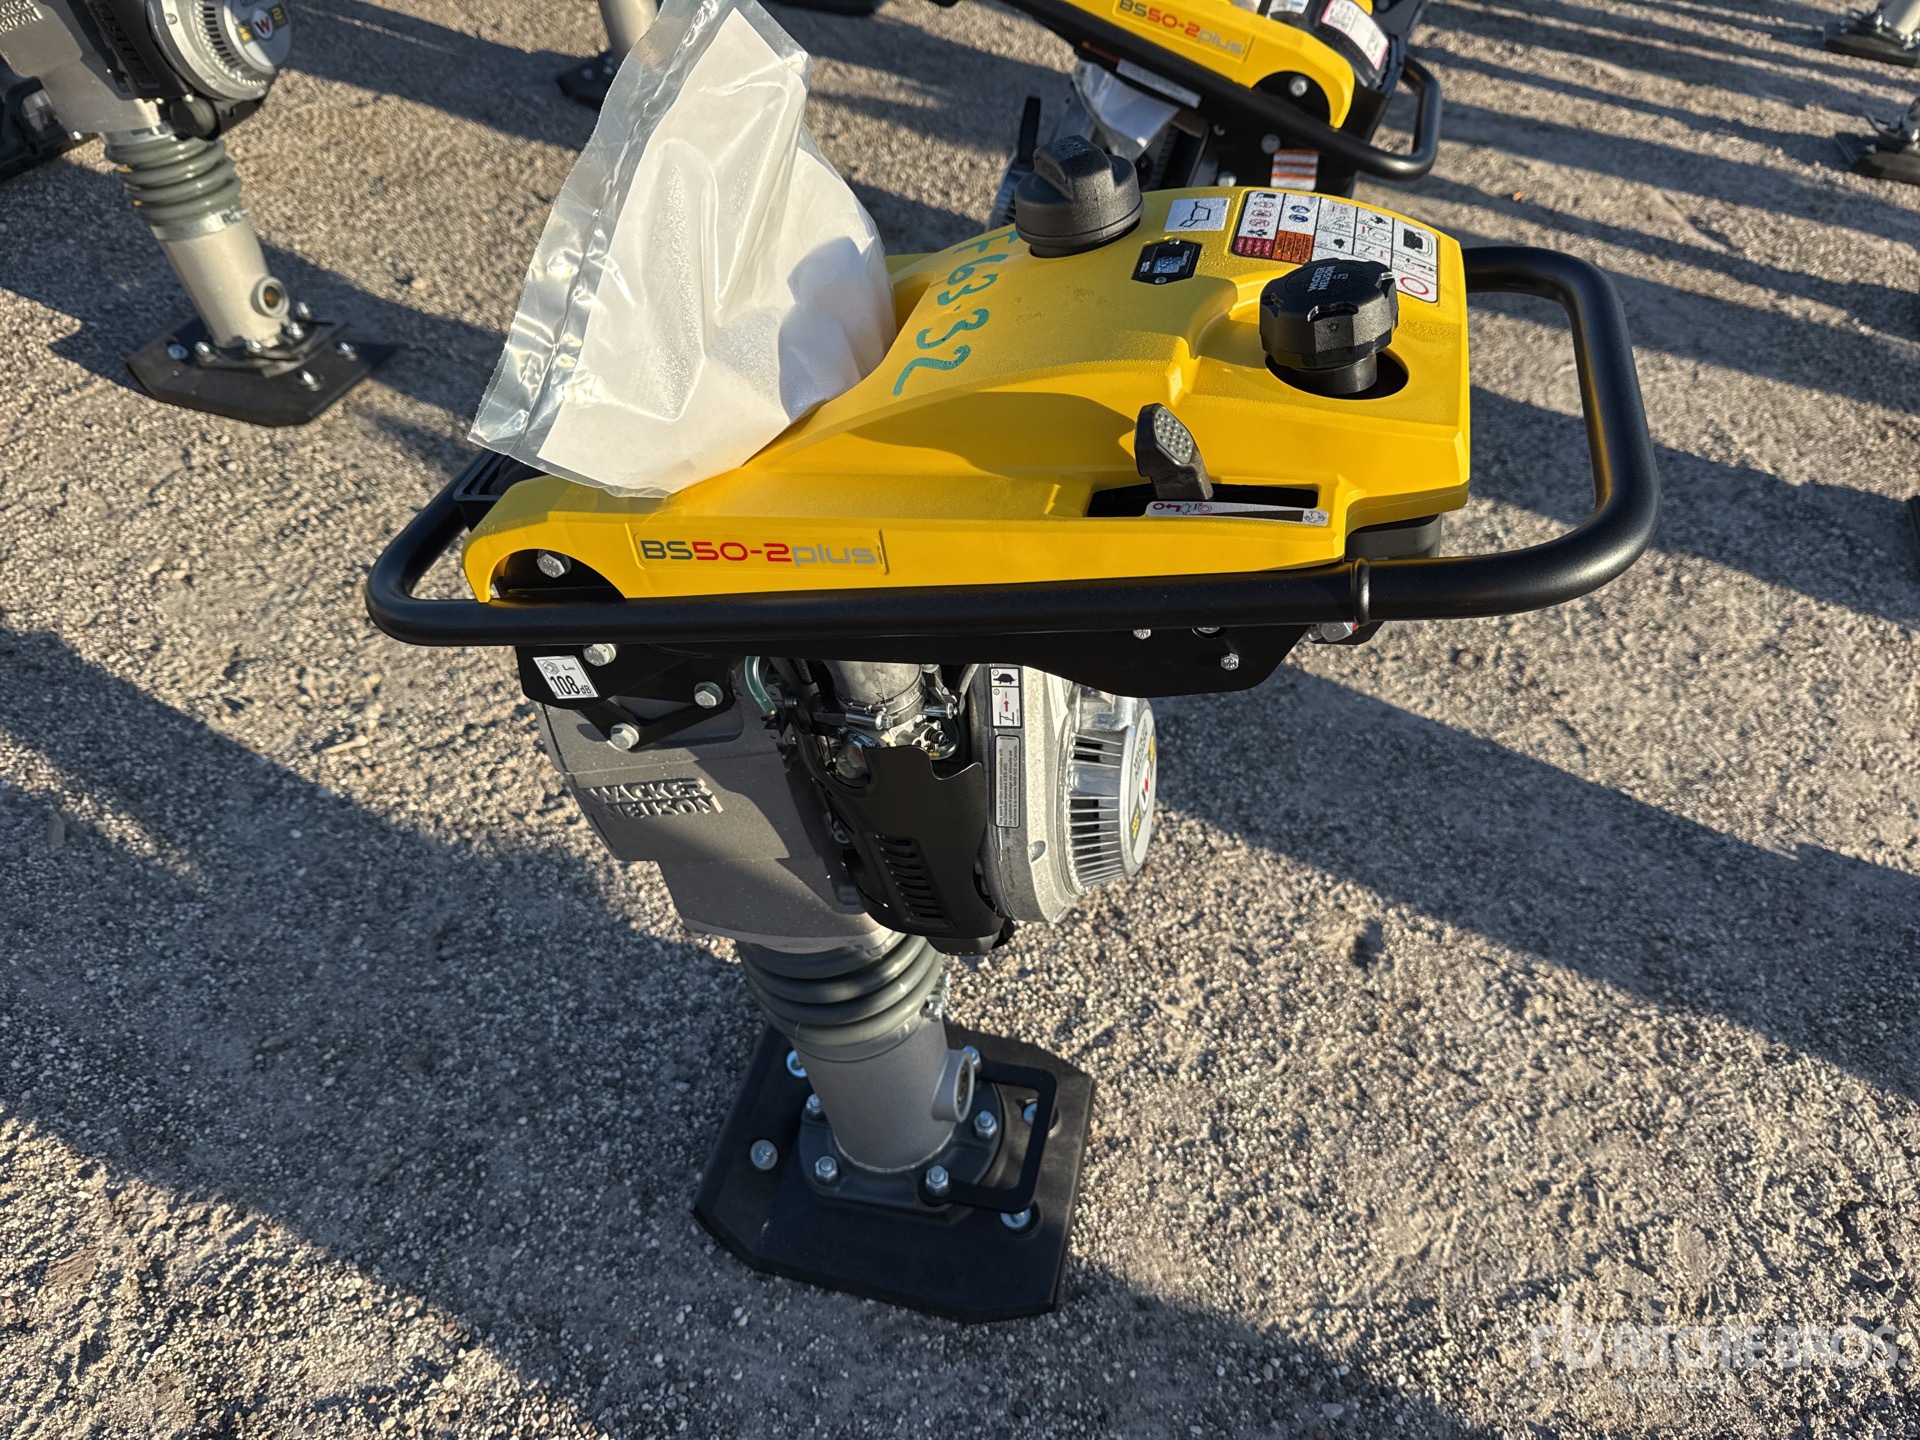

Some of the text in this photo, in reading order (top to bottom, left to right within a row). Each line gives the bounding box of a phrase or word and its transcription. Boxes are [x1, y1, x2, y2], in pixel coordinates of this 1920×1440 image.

[1118, 0, 1244, 55] BS50-2plus
[640, 539, 878, 567] BS50-2plus
[549, 675, 592, 696] 108 dB
[580, 778, 713, 804] WACKER
[602, 795, 724, 820] NEUSON
